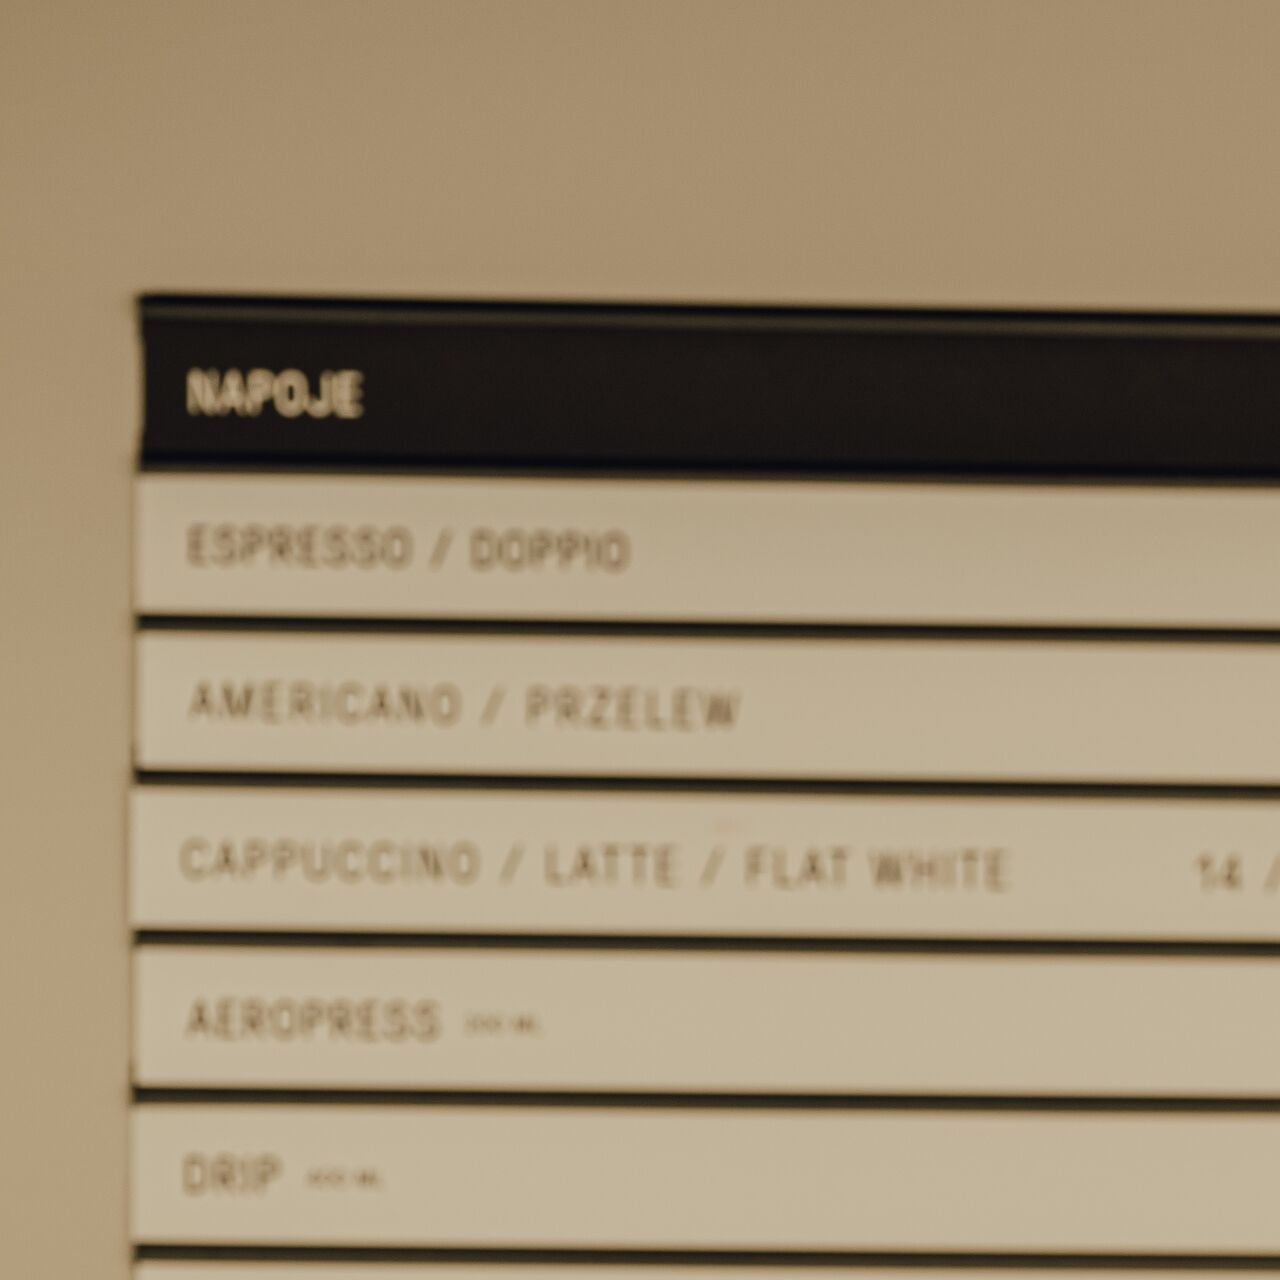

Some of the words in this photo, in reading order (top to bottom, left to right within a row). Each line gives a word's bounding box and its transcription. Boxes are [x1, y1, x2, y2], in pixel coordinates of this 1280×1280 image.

[183, 367, 367, 422] NAPOJE
[185, 521, 417, 573] ESPRESSO
[468, 525, 634, 577] DOPPIO
[188, 679, 464, 729] AMERICANO
[524, 684, 743, 734] PRZELEW
[178, 836, 484, 888] CAPPUCCINO
[543, 842, 683, 892] LATTE
[744, 844, 852, 893] FLAT
[867, 846, 1009, 896] WHITE
[1195, 852, 1246, 896] 14
[184, 995, 445, 1047] AEROPRESS
[180, 1150, 287, 1201] DRIP
